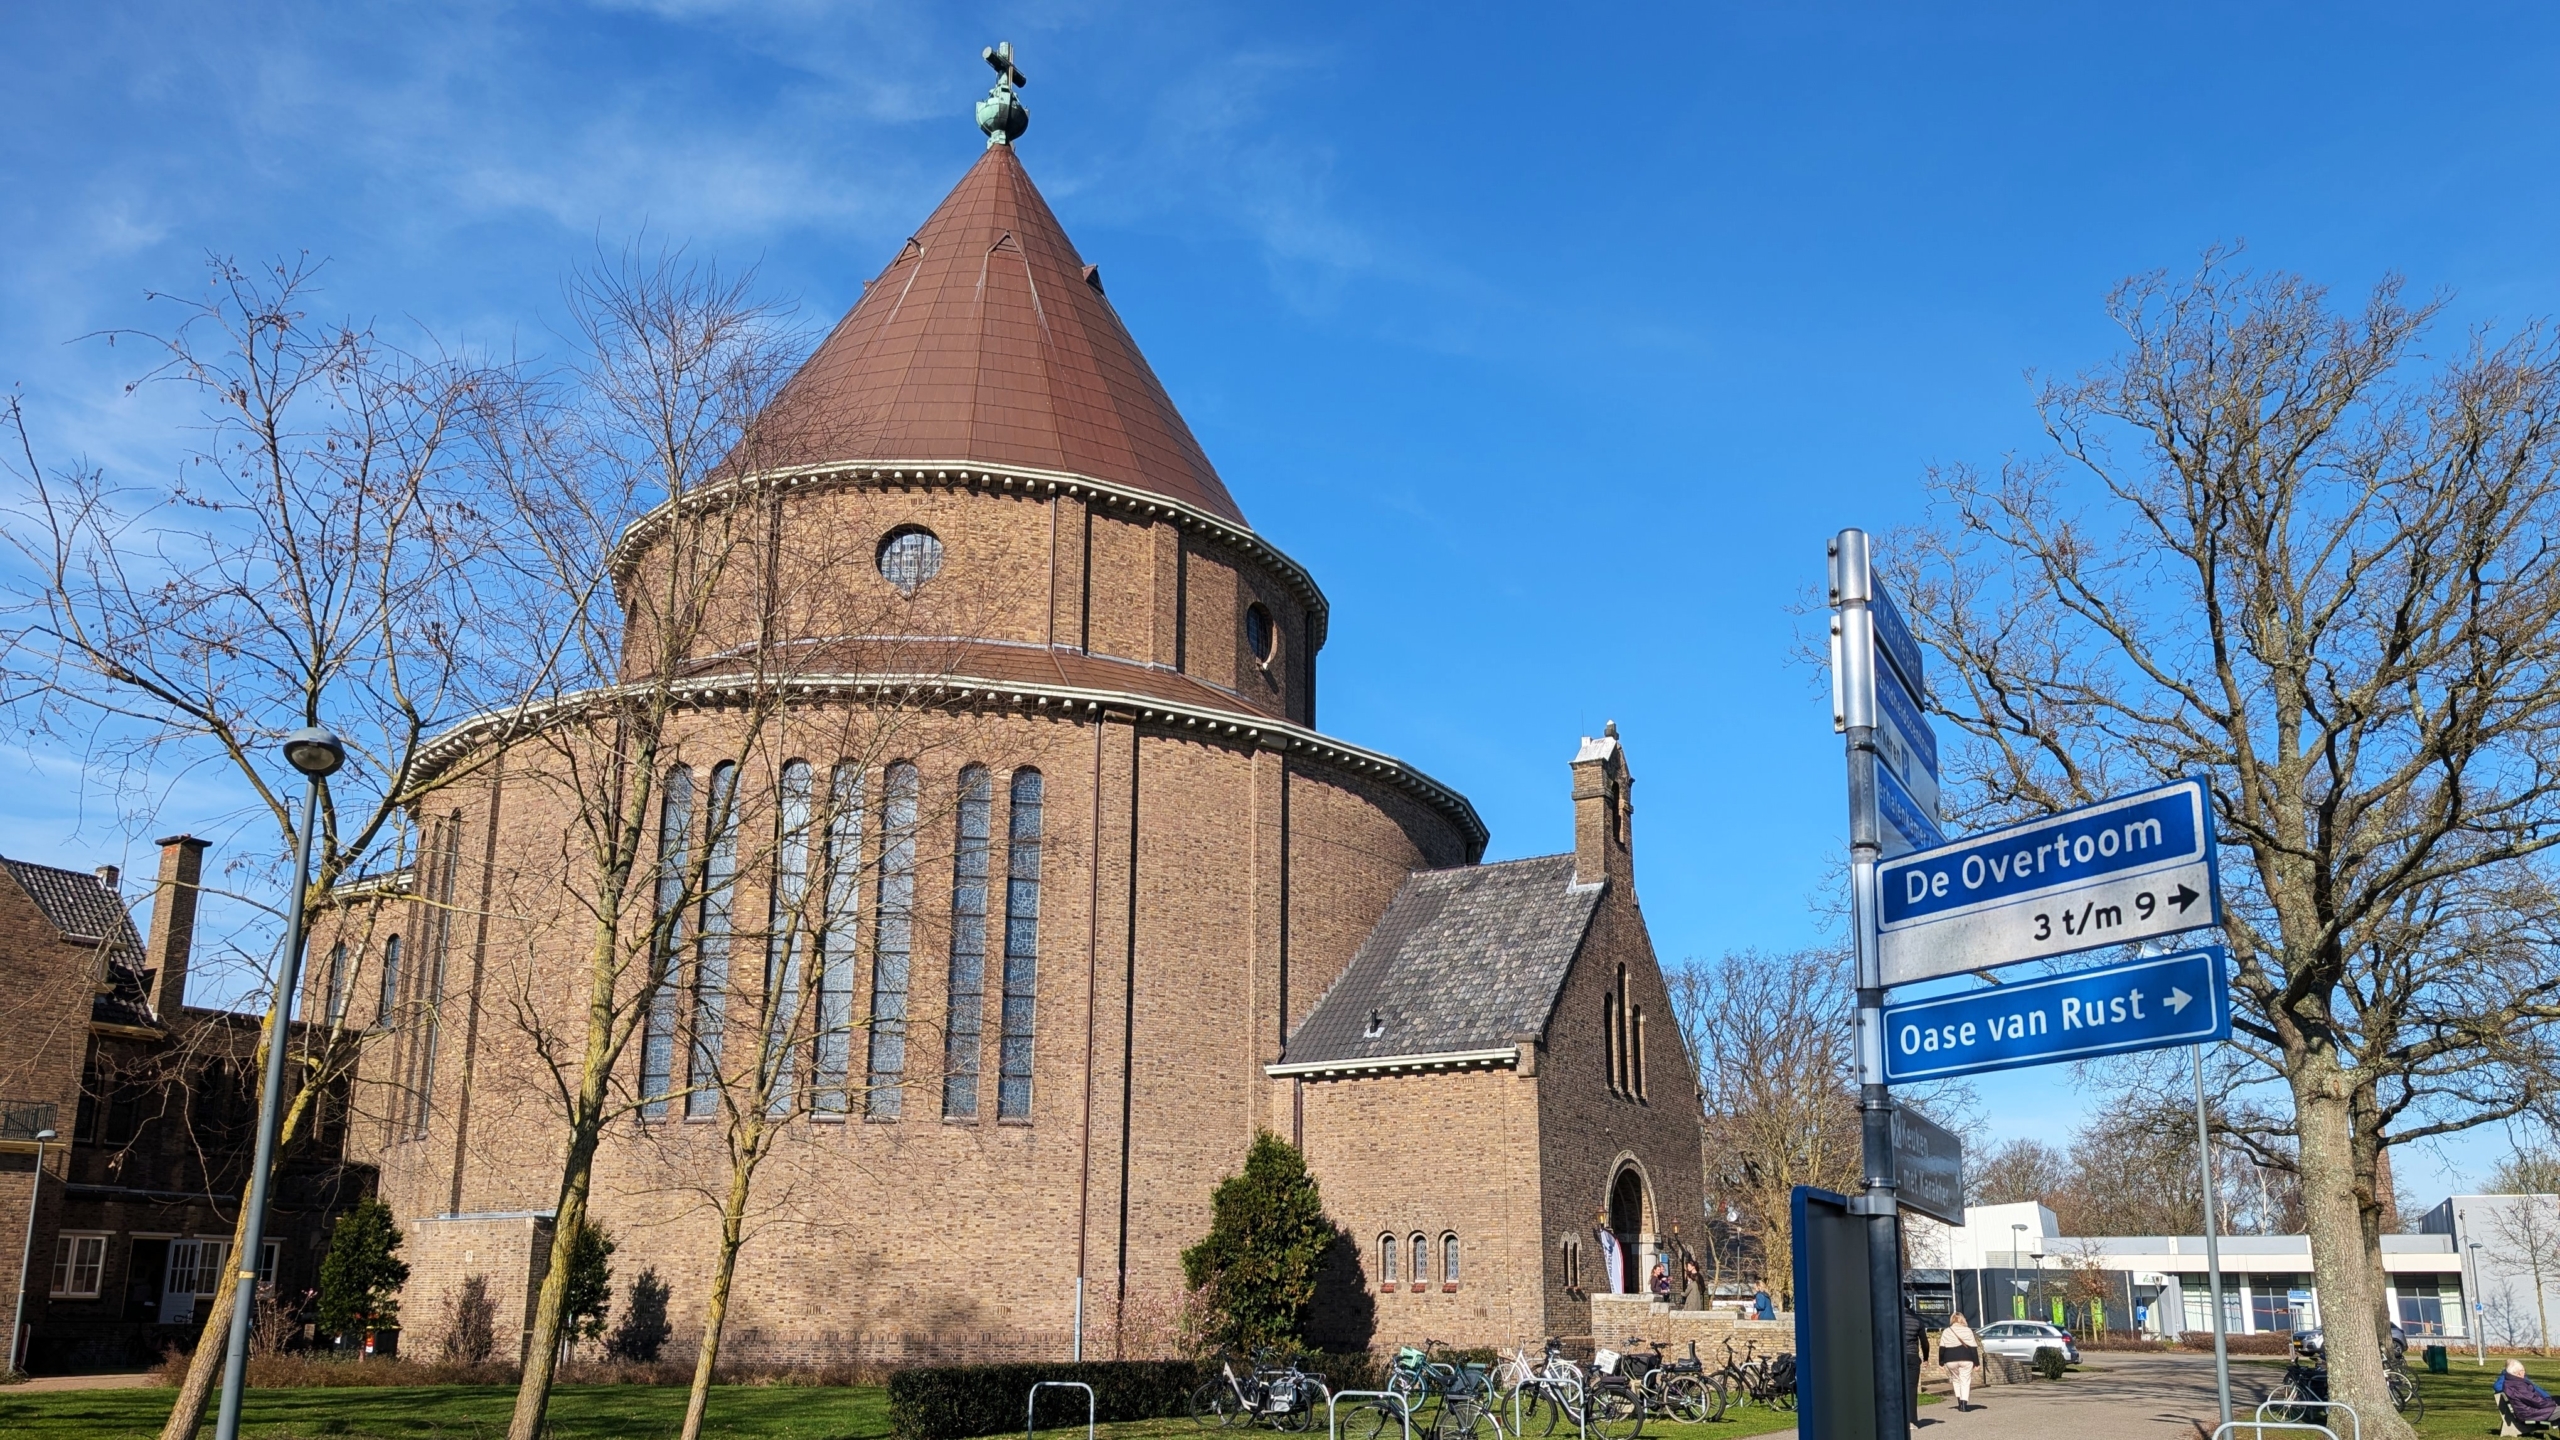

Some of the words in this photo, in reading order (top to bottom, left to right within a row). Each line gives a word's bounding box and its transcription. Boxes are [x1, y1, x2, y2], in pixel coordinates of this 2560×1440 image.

[1873, 590, 1881, 619] et
[1876, 668, 1934, 764] ezondheidscentrum
[1876, 722, 1901, 767] arkeren
[1879, 782, 1926, 848] erhalenkamer
[1906, 869, 1950, 905] De
[1962, 817, 2162, 890] Overtoom
[2033, 913, 2051, 941] 3
[2062, 902, 2122, 936] t/m
[2135, 892, 2156, 921] 9
[1900, 1021, 1977, 1056] Oase
[1988, 1009, 2047, 1042] van
[2062, 987, 2146, 1031] Rust
[1902, 1118, 1929, 1158] Keuken
[1903, 1168, 1918, 1196] met
[1920, 1170, 1949, 1208] Karakter
